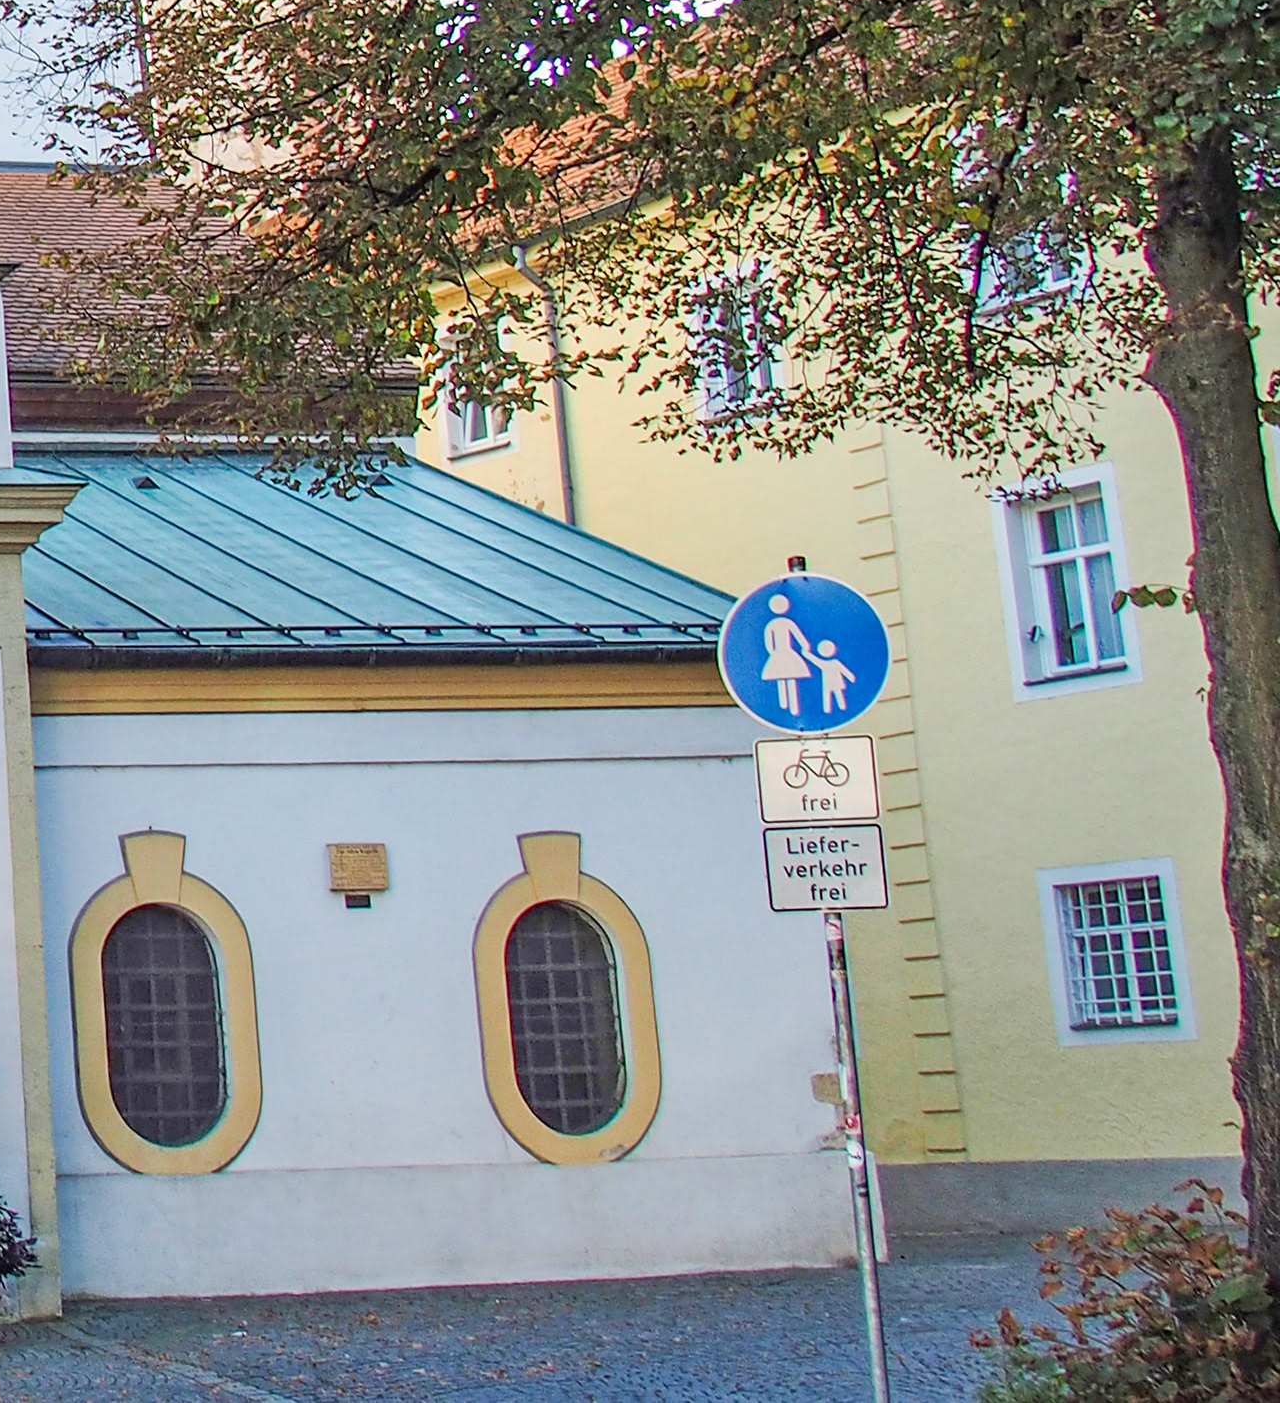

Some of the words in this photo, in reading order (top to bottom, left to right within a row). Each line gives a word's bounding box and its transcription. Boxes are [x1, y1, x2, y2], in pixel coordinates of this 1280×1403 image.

[801, 793, 837, 811] frei
[786, 836, 860, 854] Liefer-
[783, 859, 867, 878] verkehr
[810, 883, 846, 901] frei
